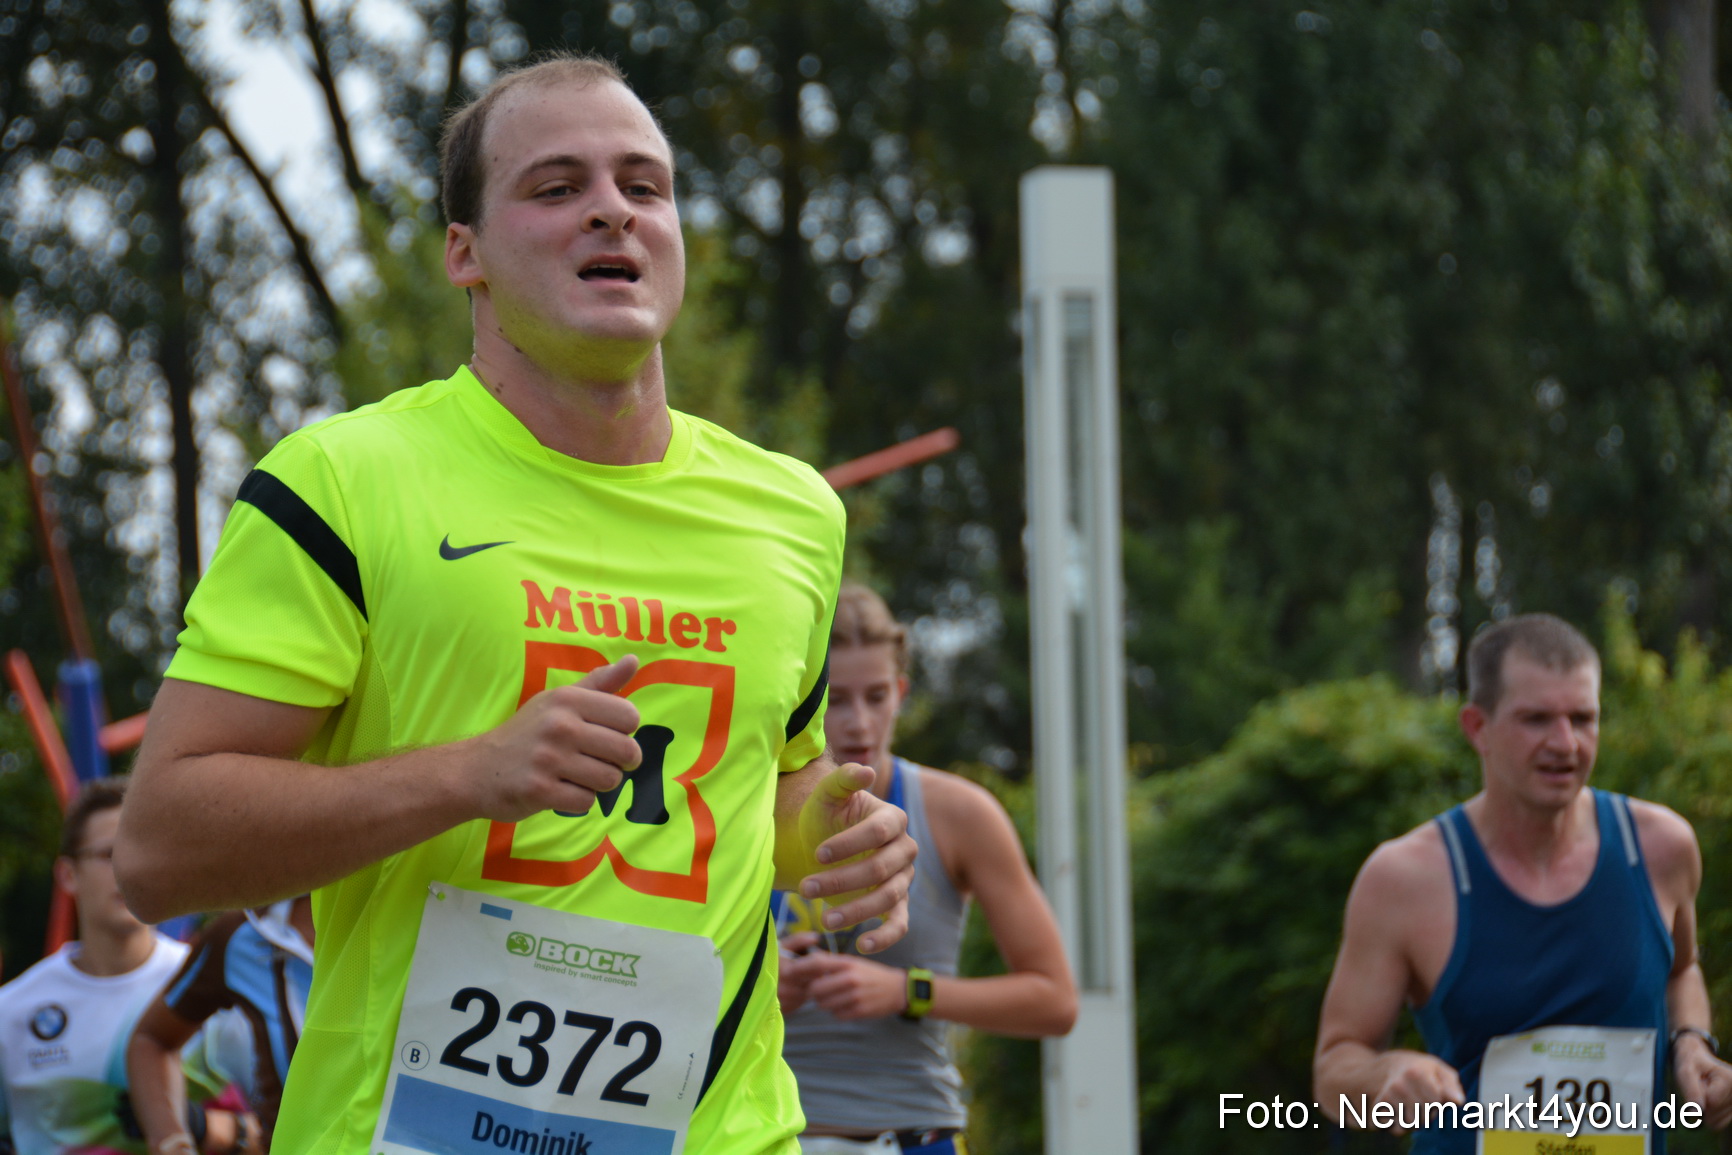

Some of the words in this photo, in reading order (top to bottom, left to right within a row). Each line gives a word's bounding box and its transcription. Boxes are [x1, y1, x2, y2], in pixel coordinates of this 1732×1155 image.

[520, 579, 737, 653] Müller
[533, 961, 566, 975] inspired
[568, 968, 578, 978] by
[580, 972, 602, 982] smart
[603, 976, 638, 988] concepts
[536, 936, 641, 978] BOCK
[409, 1047, 421, 1064] B
[439, 986, 662, 1107] 2372
[471, 1110, 593, 1155] Dominik
